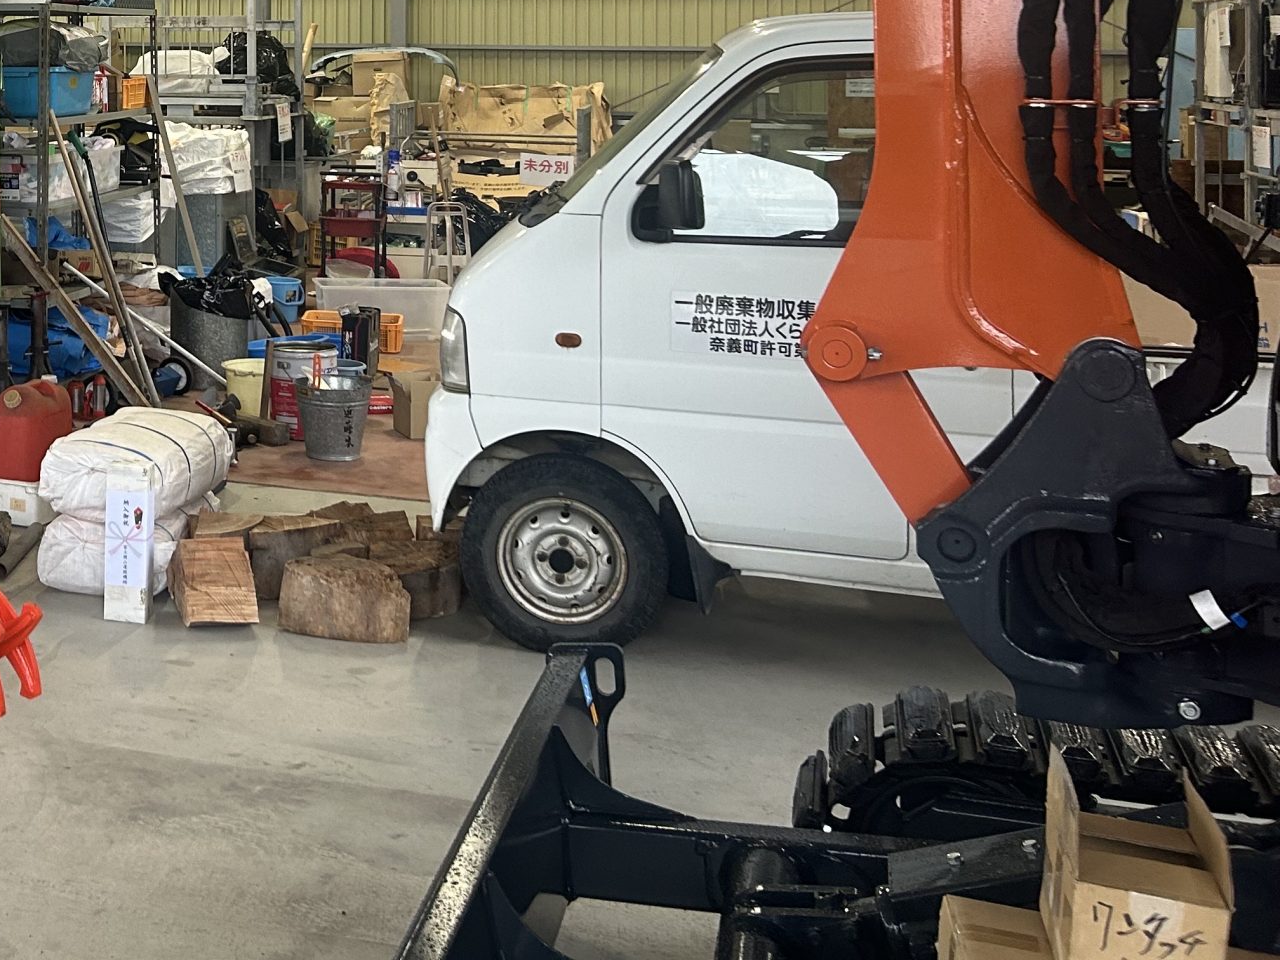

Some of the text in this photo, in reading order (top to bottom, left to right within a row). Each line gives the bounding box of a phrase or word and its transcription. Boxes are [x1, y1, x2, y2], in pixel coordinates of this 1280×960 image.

[523, 158, 569, 175] 未分別
[674, 293, 816, 321] 一般廃棄物収集
[675, 315, 803, 340] 一般社団法人くら
[1092, 901, 1208, 959] ワンタッチ
